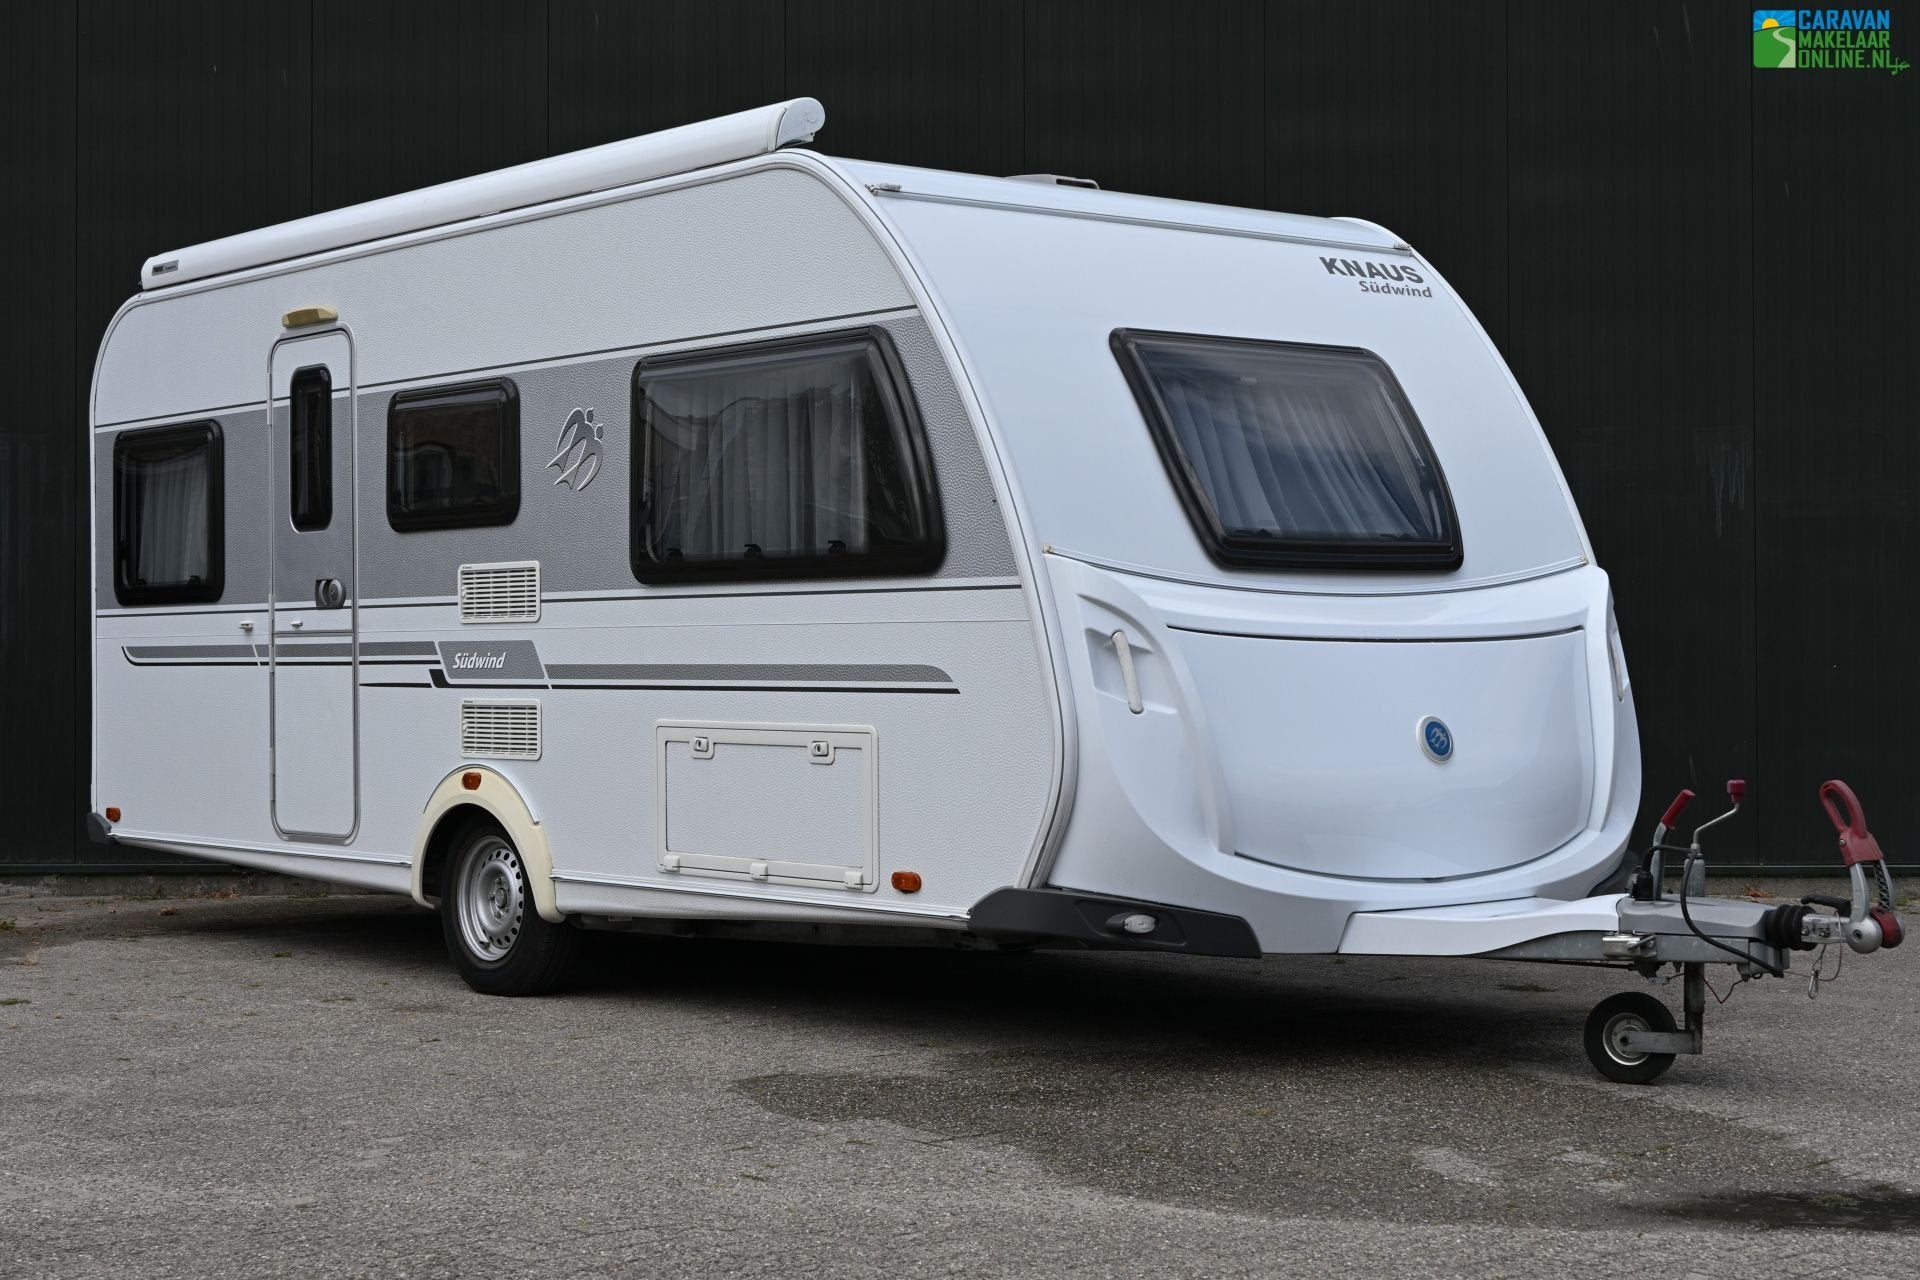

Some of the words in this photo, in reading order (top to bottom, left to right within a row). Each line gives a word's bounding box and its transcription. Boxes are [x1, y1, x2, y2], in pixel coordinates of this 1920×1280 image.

[1319, 256, 1424, 283] KNAUS
[1359, 280, 1433, 298] Südwind
[453, 652, 507, 669] Südwind
